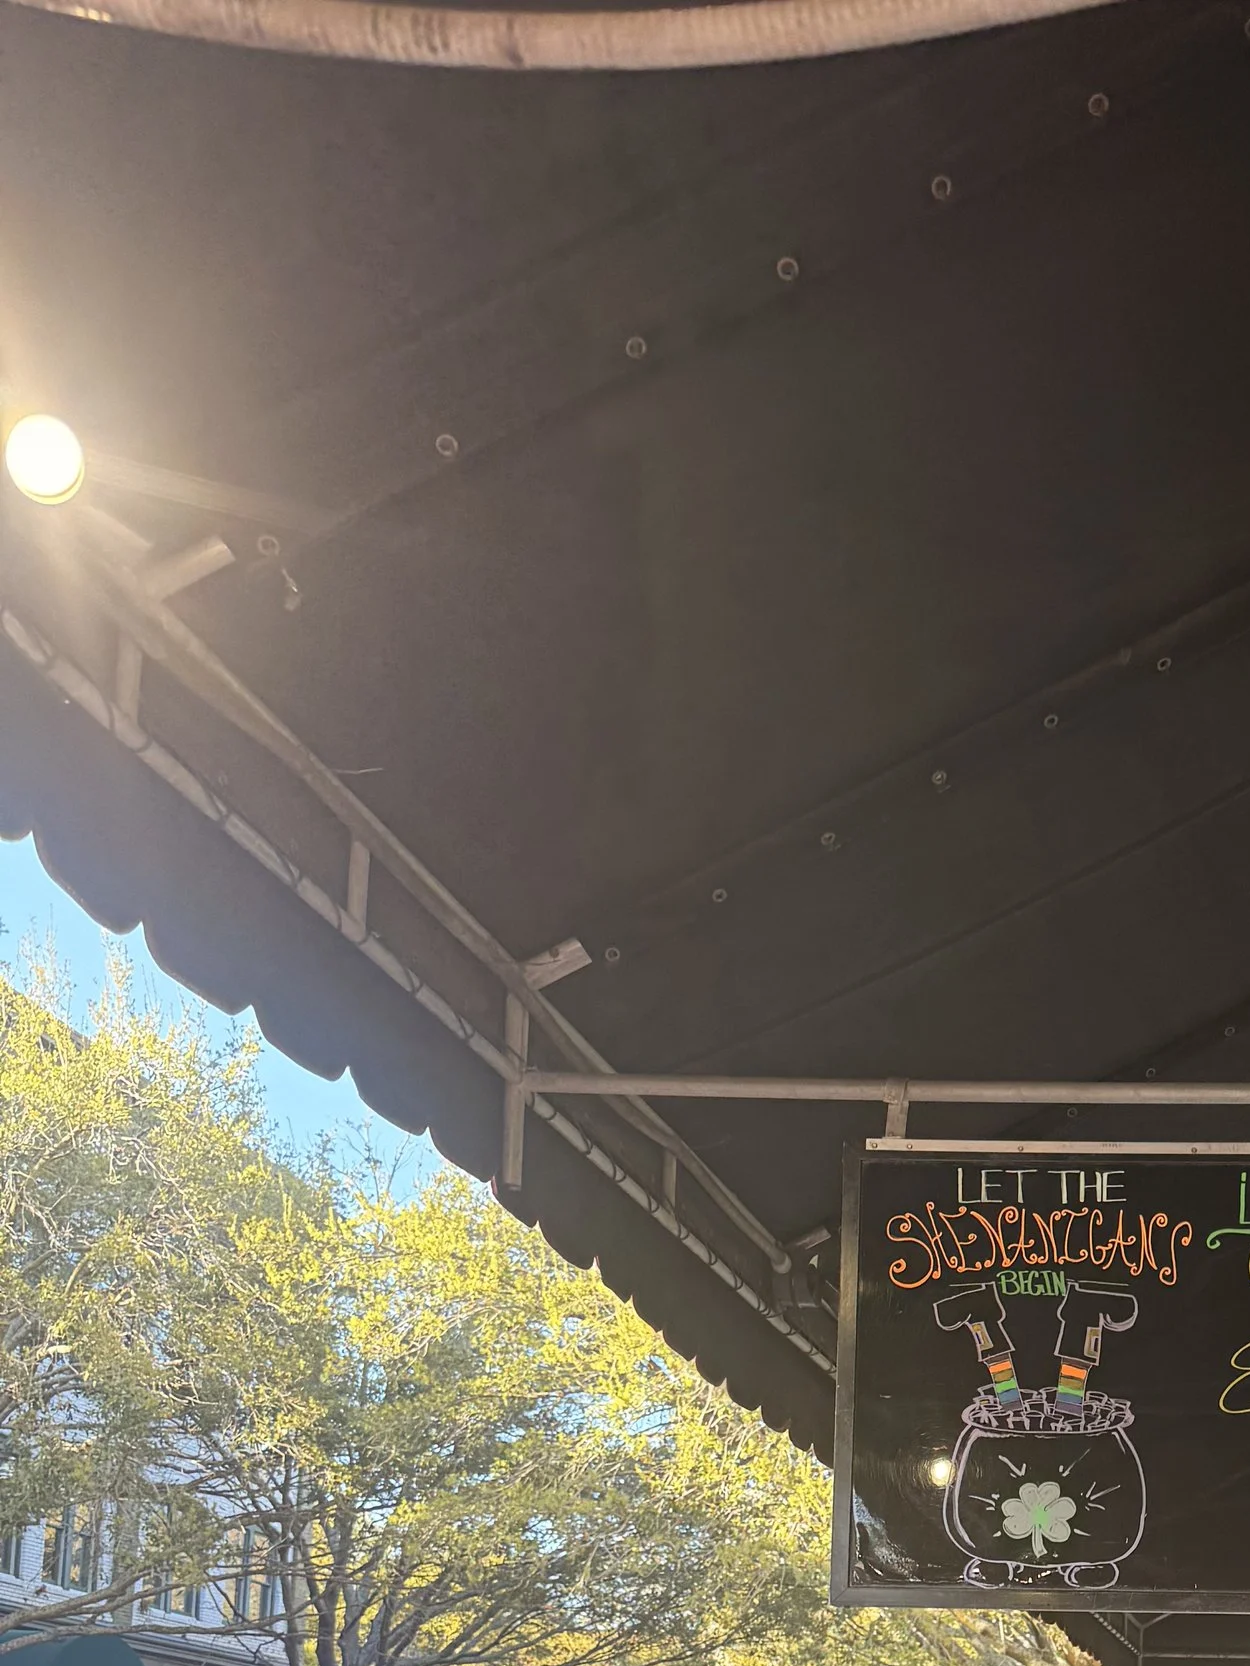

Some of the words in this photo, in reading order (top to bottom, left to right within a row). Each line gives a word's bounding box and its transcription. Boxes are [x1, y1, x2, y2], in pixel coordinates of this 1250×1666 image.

[957, 1168, 1038, 1203] LET
[1048, 1169, 1127, 1204] THE
[886, 1201, 1193, 1289] SHENANIGANS
[996, 1270, 1067, 1297] BEGIN
